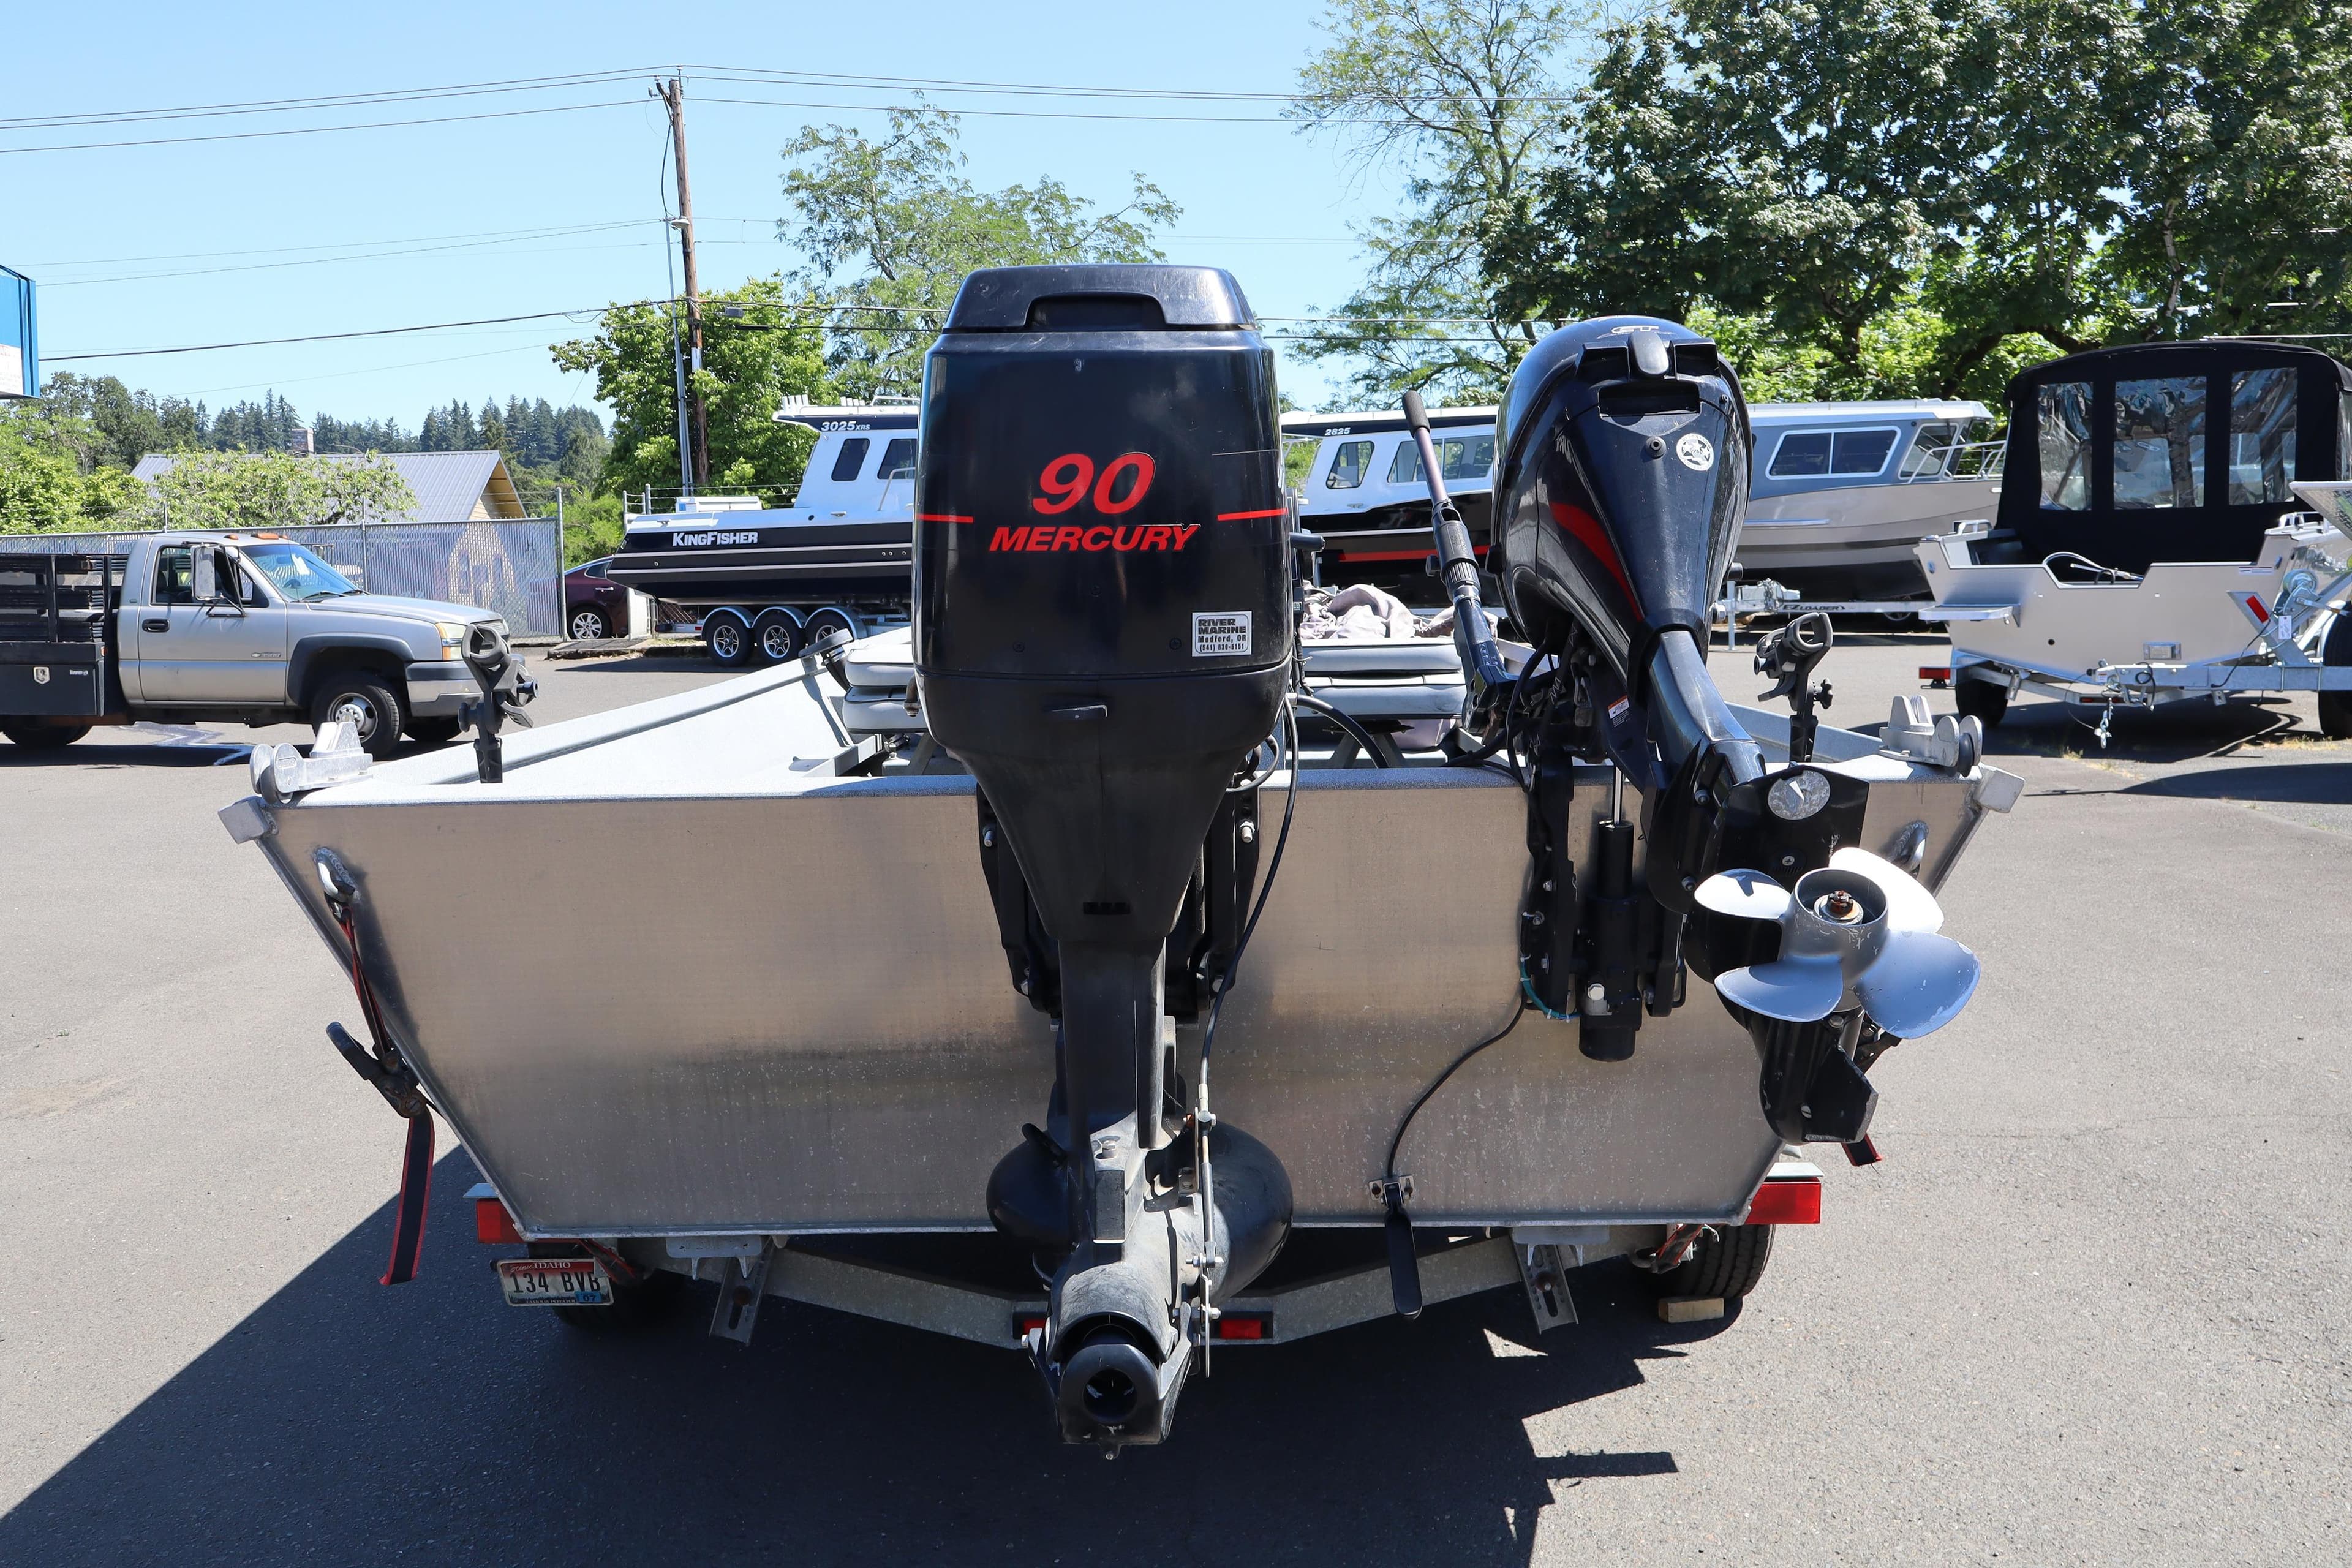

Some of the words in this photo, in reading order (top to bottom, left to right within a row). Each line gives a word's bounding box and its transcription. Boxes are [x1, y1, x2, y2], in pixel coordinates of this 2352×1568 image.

[1324, 427, 1351, 435] 2825
[1032, 452, 1156, 514] 90
[989, 524, 1201, 551] MERCURY
[509, 1272, 549, 1294] 134
[560, 1271, 601, 1293] BVB
